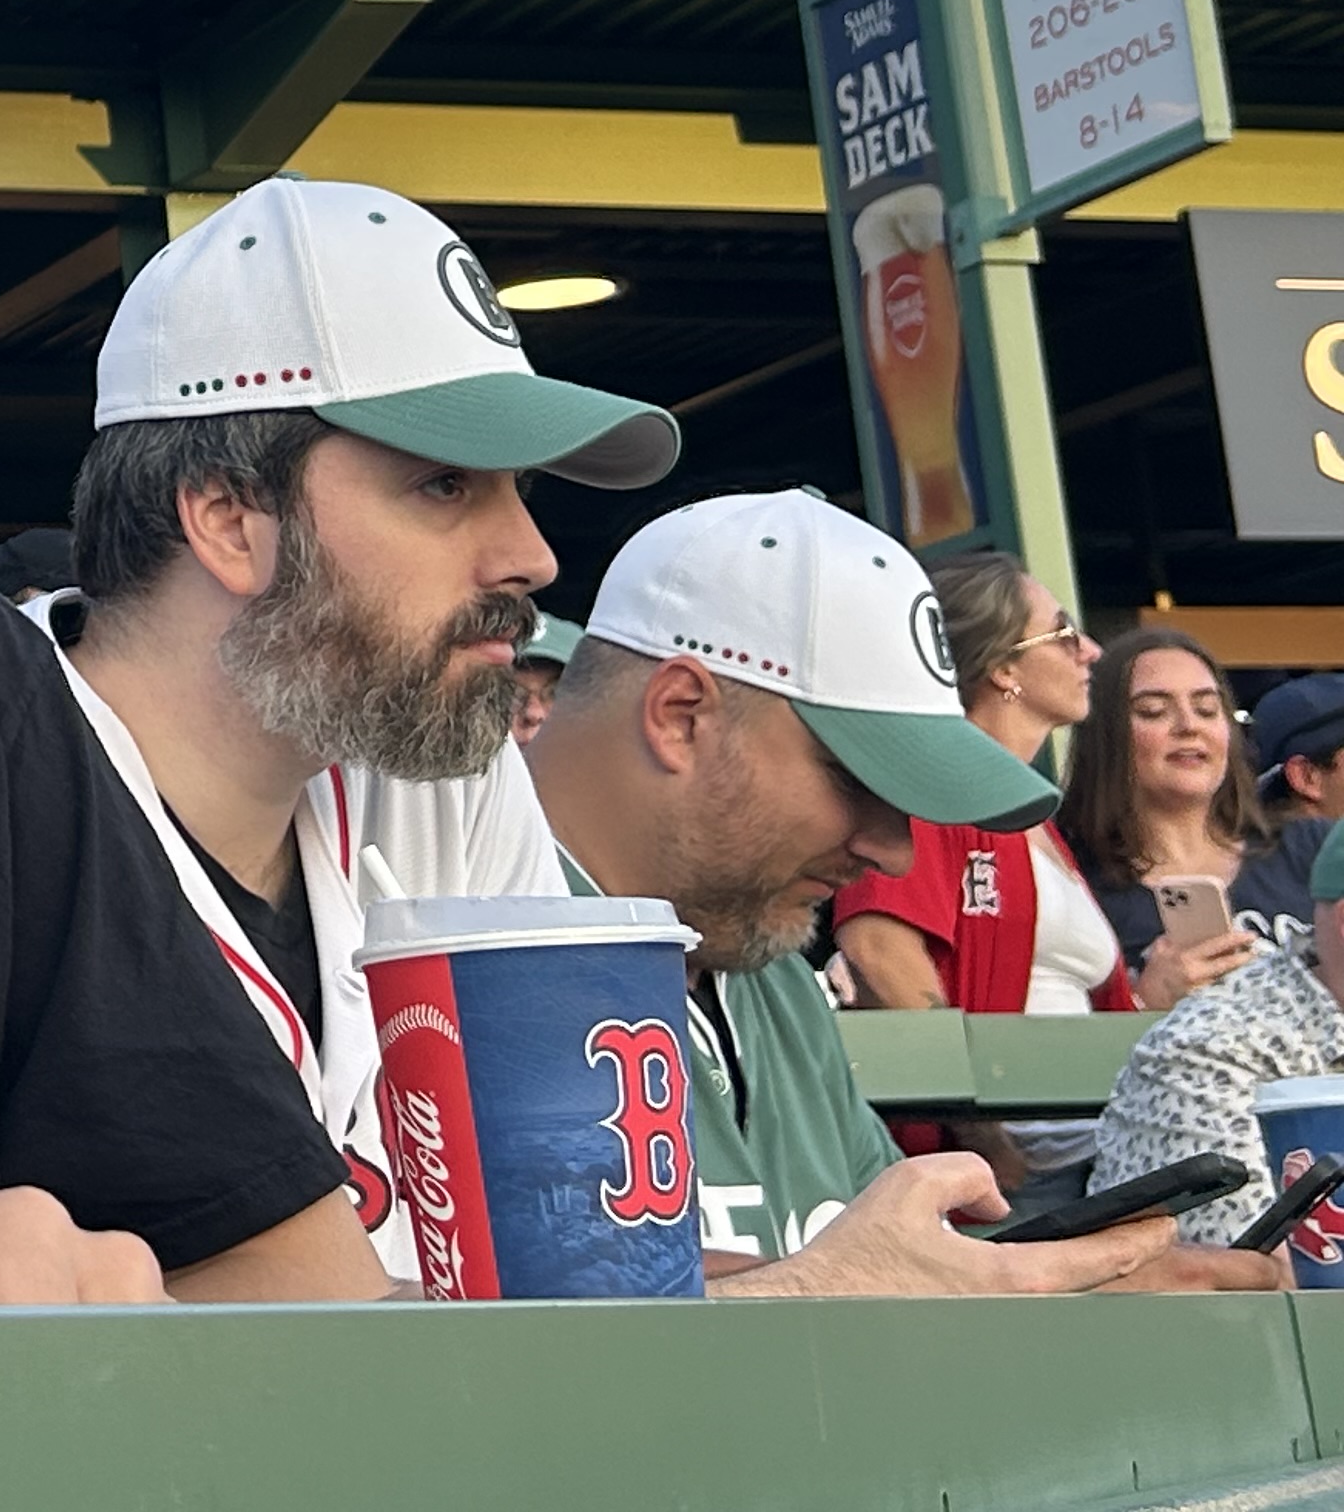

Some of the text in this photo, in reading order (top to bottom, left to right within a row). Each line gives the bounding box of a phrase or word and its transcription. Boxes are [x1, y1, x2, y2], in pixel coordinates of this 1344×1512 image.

[835, 39, 927, 136] SAM
[1033, 21, 1176, 113] BARSTOOLS
[842, 101, 936, 190] DECK
[1079, 92, 1145, 150] 8-14
[585, 1018, 696, 1227] B
